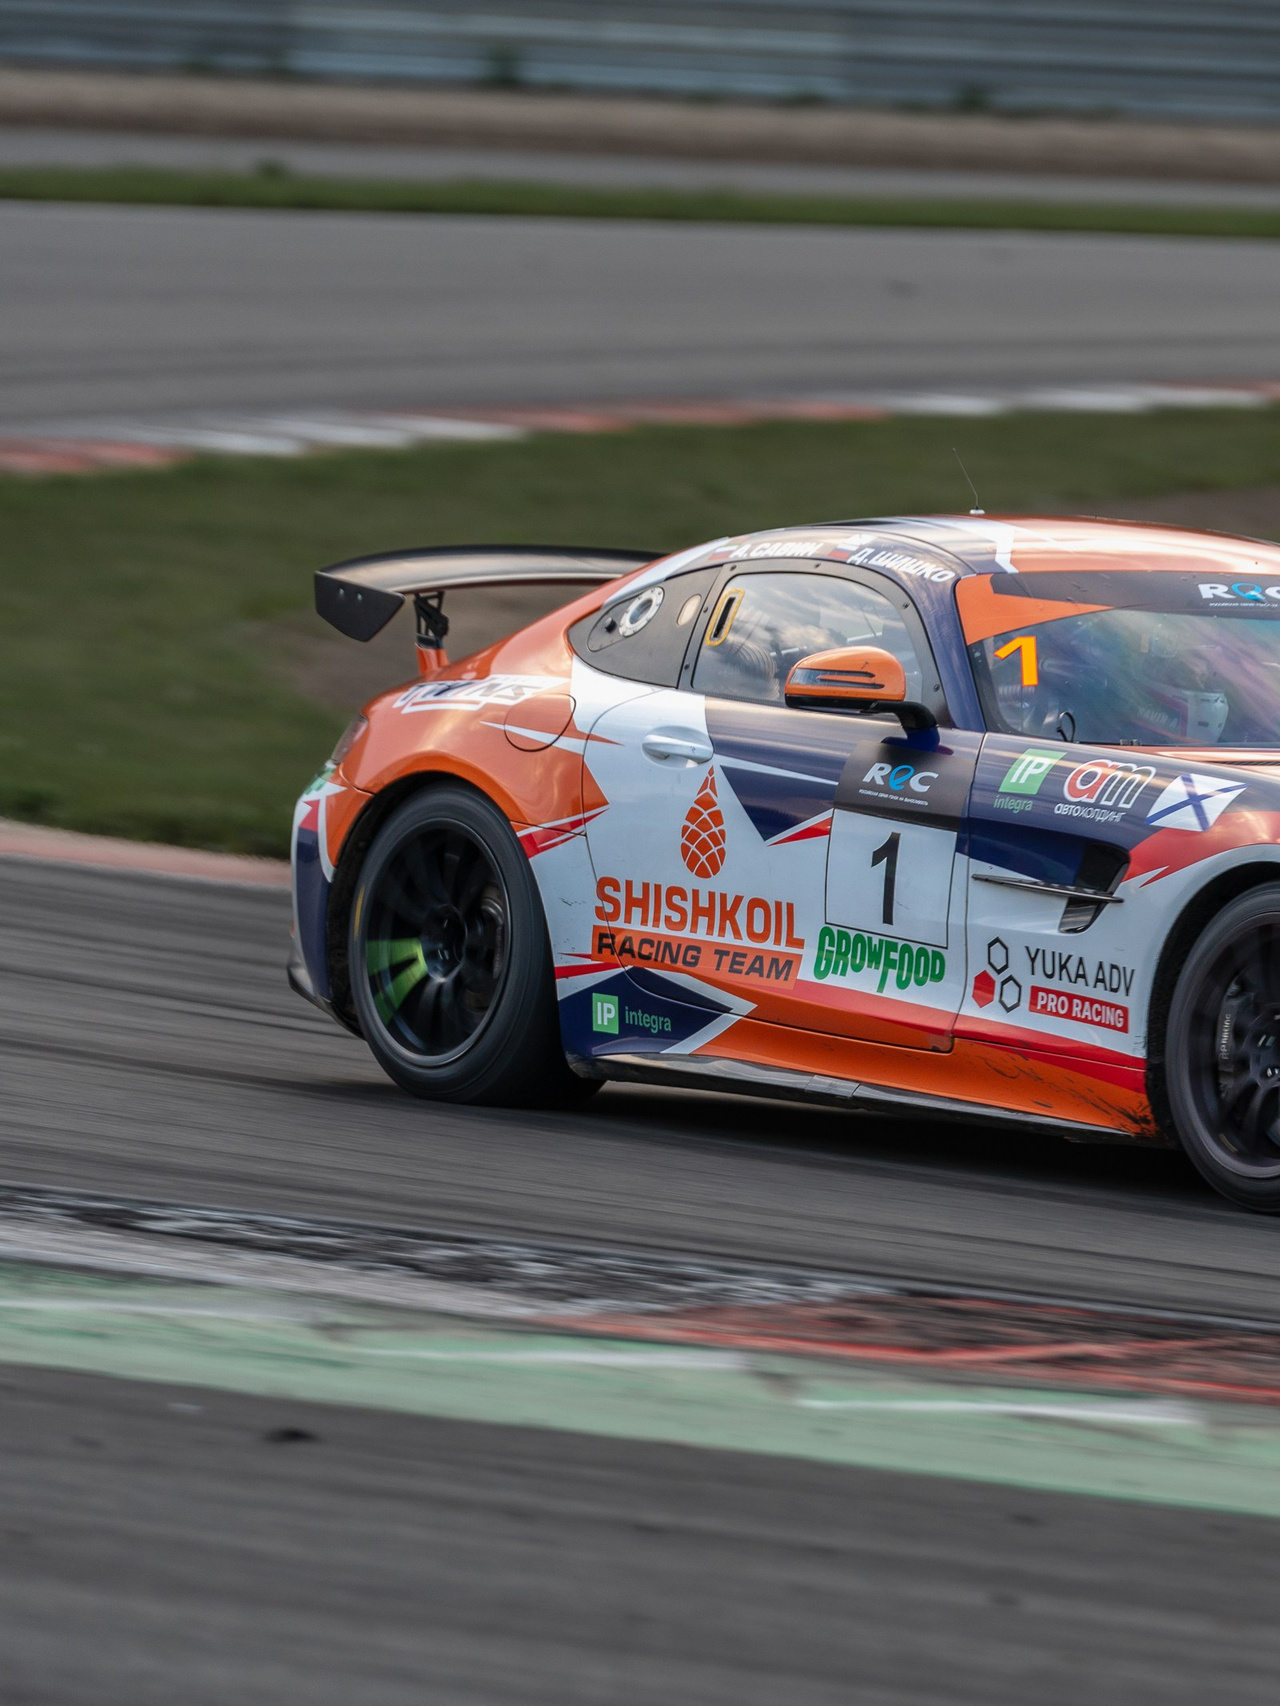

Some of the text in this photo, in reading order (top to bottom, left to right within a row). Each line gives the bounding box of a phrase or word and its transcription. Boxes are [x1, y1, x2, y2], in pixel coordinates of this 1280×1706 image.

[993, 635, 1039, 688] 1
[1010, 755, 1051, 784] IP
[993, 795, 1034, 814] integra
[871, 831, 901, 926] 1
[594, 876, 805, 950] SHISHKOIL
[597, 932, 794, 982] RACING TEAM
[1025, 945, 1135, 997] YUKA ADV
[597, 1001, 616, 1026] IP
[625, 1006, 672, 1033] integra
[1037, 991, 1124, 1028] PRO RACING
